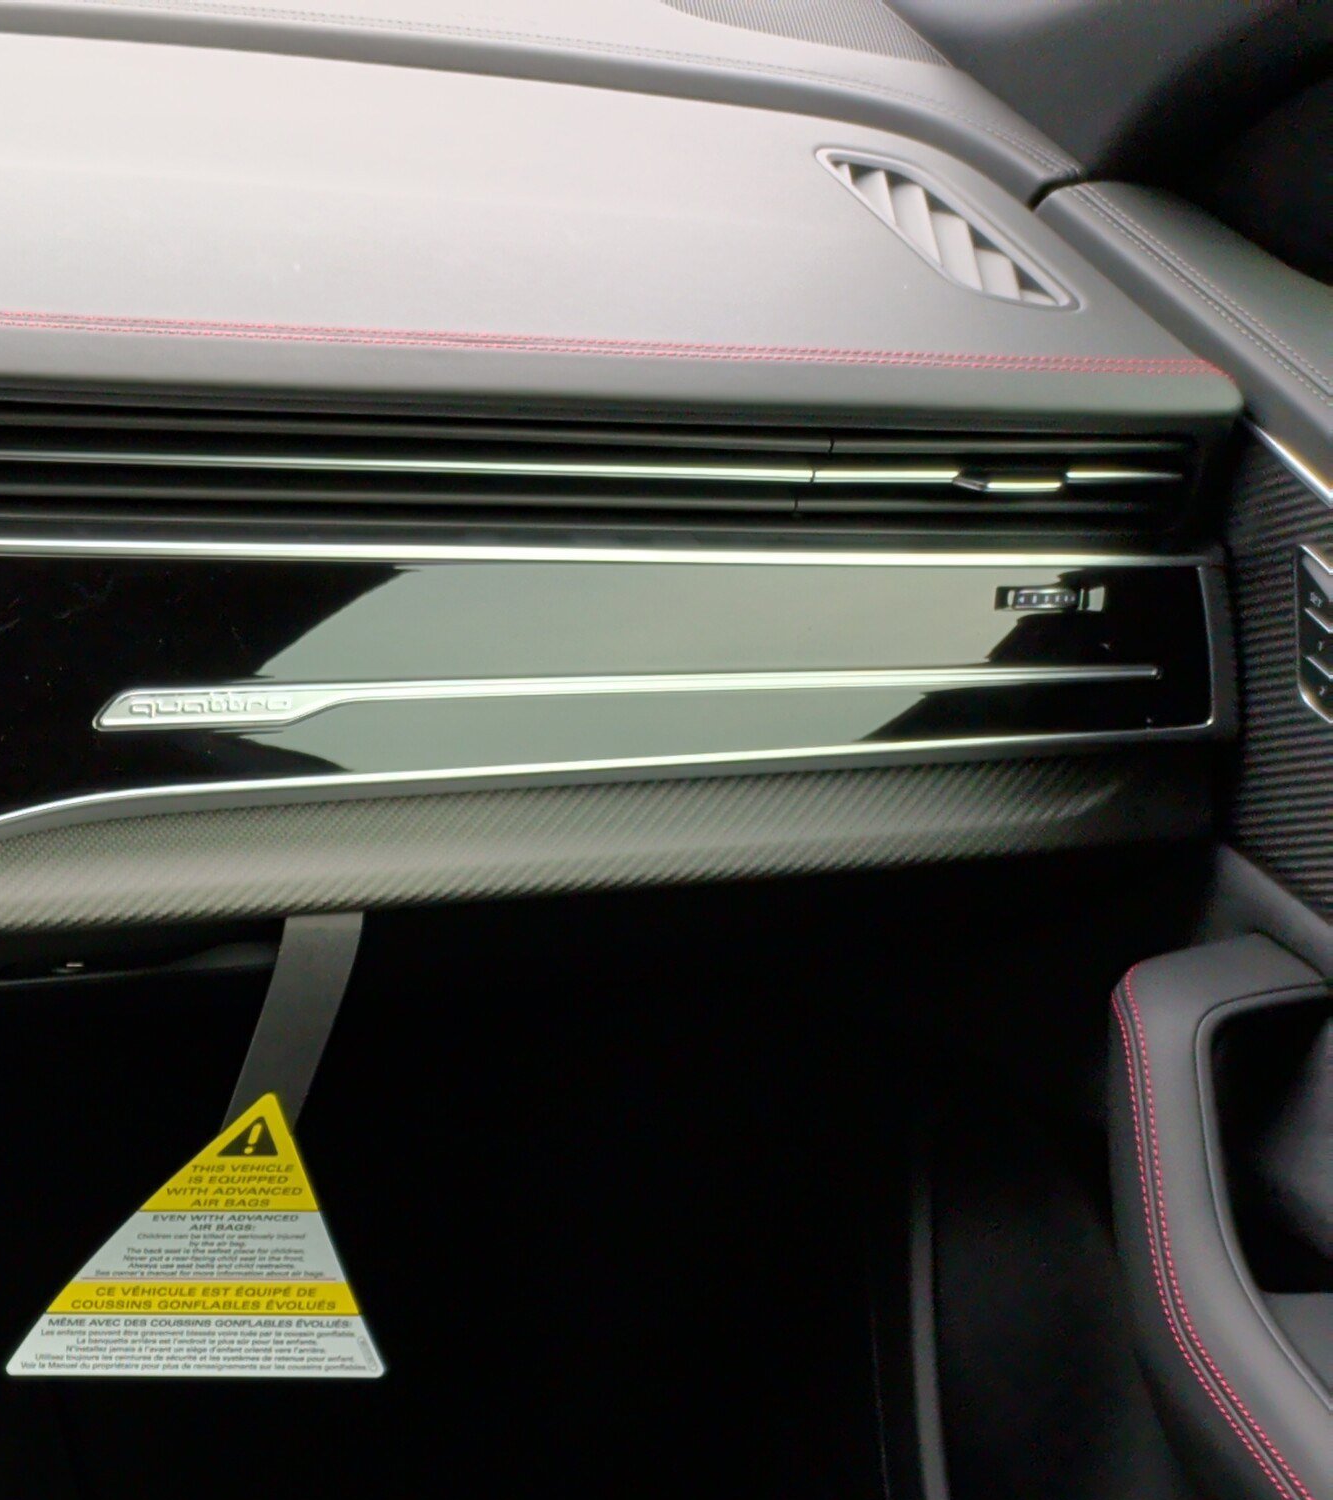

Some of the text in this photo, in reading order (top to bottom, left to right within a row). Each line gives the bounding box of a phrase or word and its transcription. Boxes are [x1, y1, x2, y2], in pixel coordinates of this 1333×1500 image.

[130, 691, 292, 718] quattro
[192, 1164, 294, 1173] THIS VEHICLE
[188, 1175, 289, 1185] IS EQUIPPED
[166, 1187, 303, 1196] WITH ADVANCED
[191, 1199, 271, 1208] AIR BAGS
[152, 1214, 299, 1222] EVEN WITH ADVANCED
[96, 1285, 317, 1297] CE VÉHICULE EST ÉQUIPÉ DE
[71, 1299, 337, 1311] COUSSINS GONFLABLES ÉVOLUÉS
[48, 1317, 85, 1327] MÊME
[89, 1319, 120, 1327] AVEC
[123, 1319, 147, 1327] DES
[150, 1319, 211, 1327] COUSSINS
[215, 1319, 293, 1328] GONFLABLES
